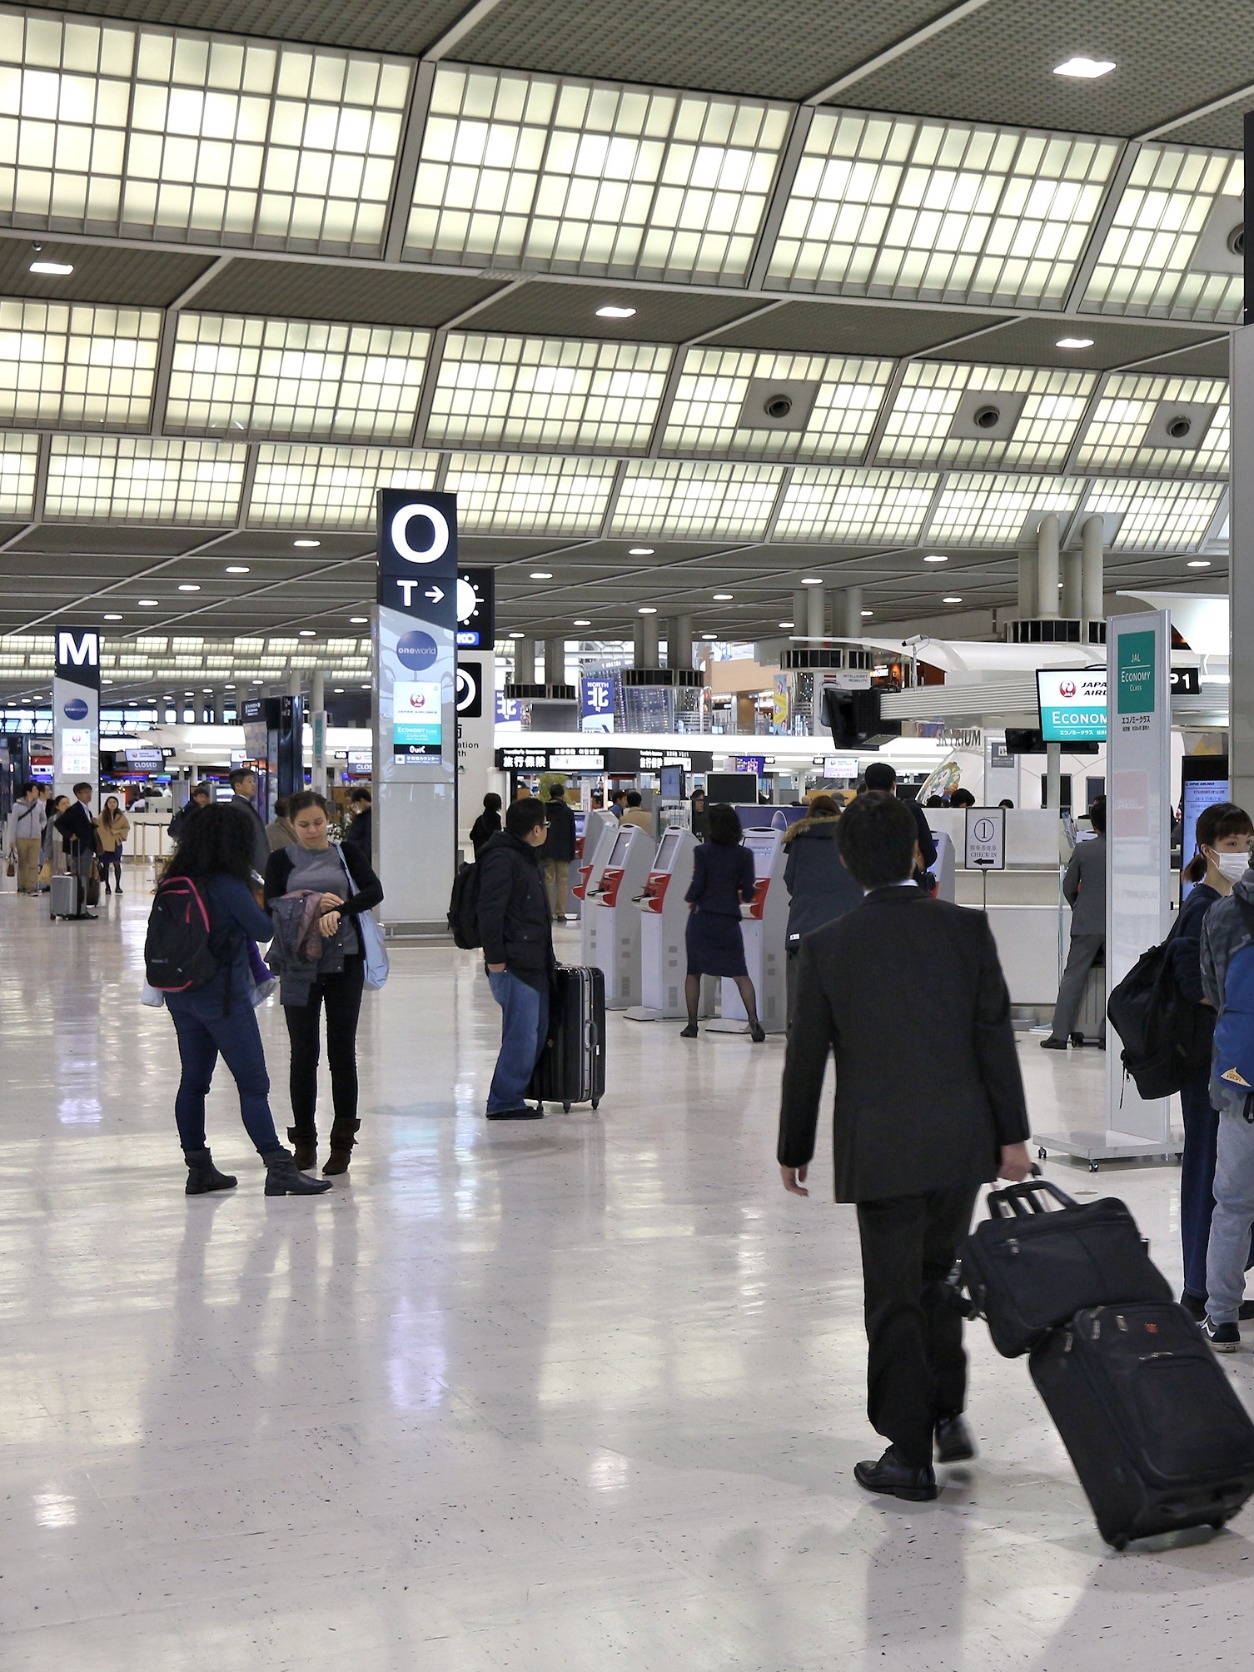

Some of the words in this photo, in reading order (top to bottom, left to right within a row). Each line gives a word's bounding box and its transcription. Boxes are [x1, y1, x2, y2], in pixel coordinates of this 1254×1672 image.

[391, 503, 450, 564] O
[396, 579, 418, 607] T
[58, 632, 98, 666] M
[398, 645, 437, 656] oneworld
[1130, 653, 1141, 663] JAL
[1121, 671, 1151, 683] ECONOMY
[587, 687, 609, 708] 北
